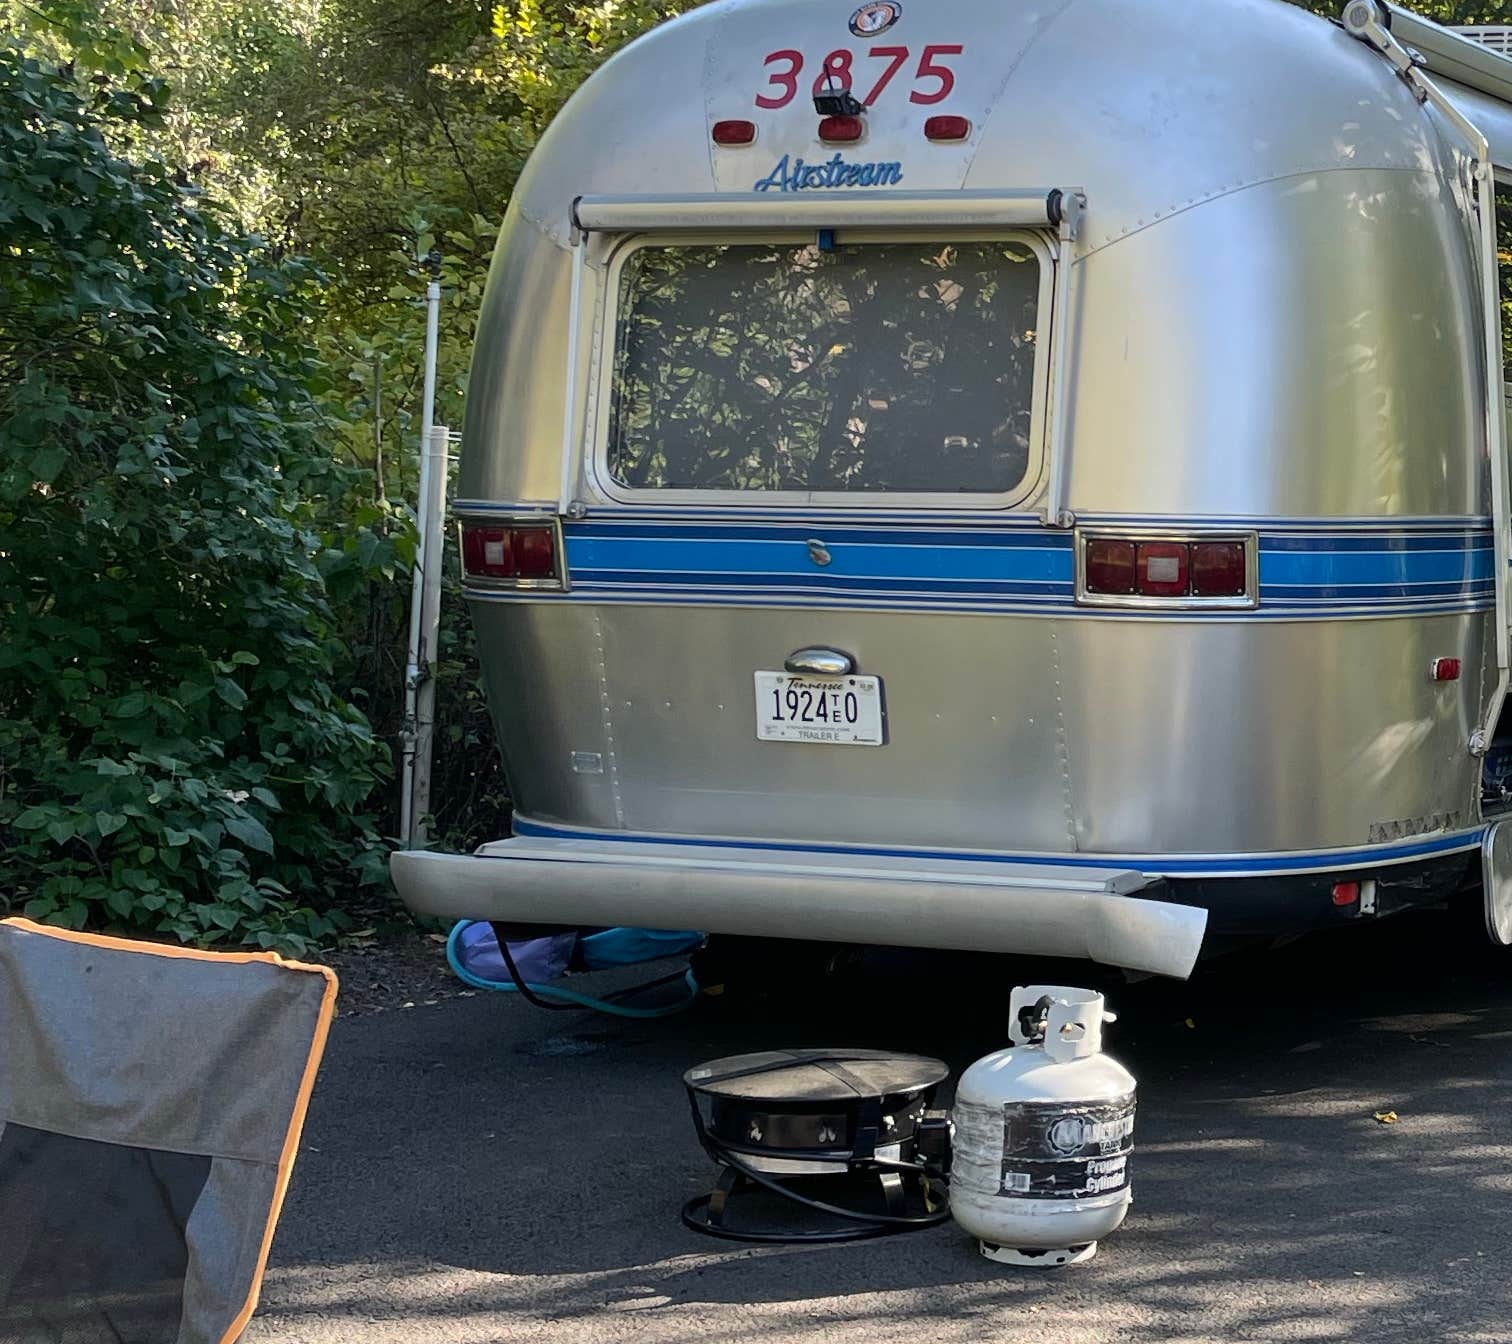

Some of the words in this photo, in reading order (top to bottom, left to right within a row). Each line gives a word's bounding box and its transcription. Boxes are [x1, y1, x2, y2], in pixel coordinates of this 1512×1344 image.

[755, 45, 963, 109] 3875
[754, 153, 903, 192] Airstream
[787, 677, 844, 691] Tennessee
[799, 731, 833, 741] TRAILER
